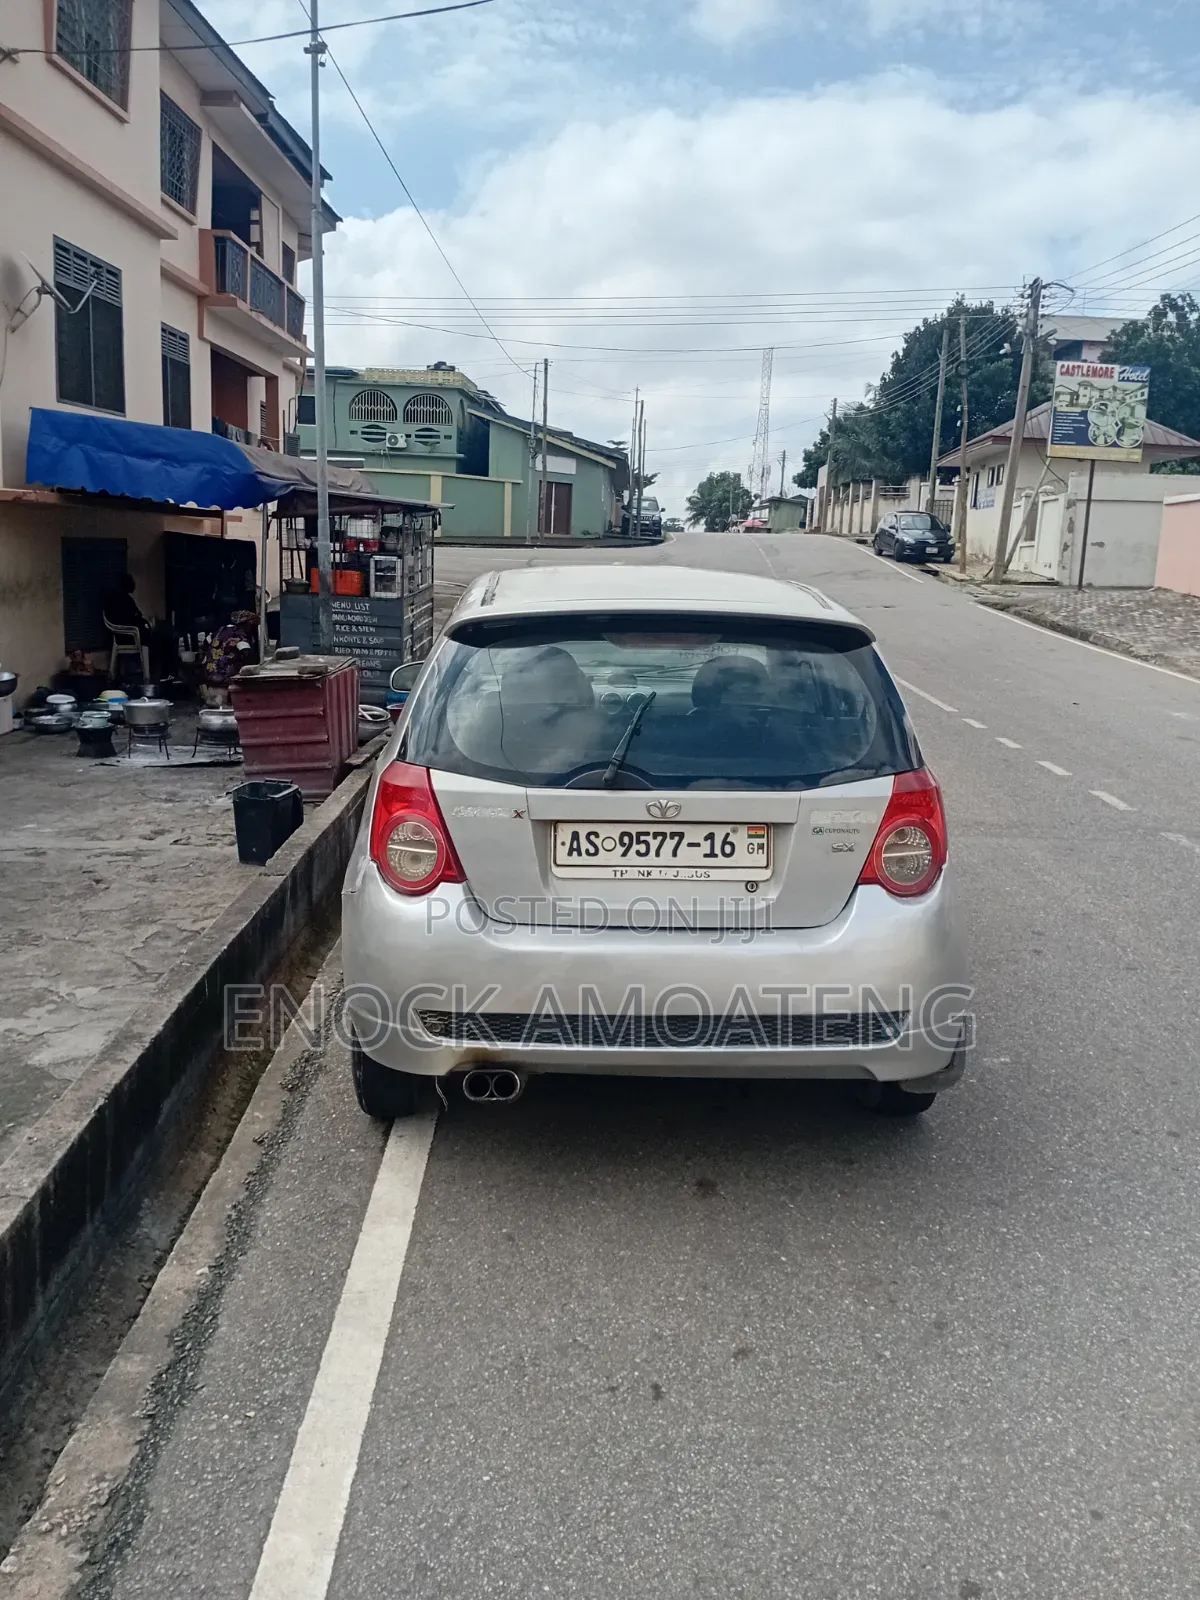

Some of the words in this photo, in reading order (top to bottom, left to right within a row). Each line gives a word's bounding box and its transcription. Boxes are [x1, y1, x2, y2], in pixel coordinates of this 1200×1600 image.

[1060, 363, 1115, 379] CASTLEMORE
[1119, 366, 1150, 381] Hotel
[331, 601, 351, 609] MENU
[354, 603, 370, 611] LIST
[335, 624, 350, 632] RICE
[567, 831, 600, 857] AS
[618, 831, 736, 858] 9577-16
[832, 842, 855, 853] SX
